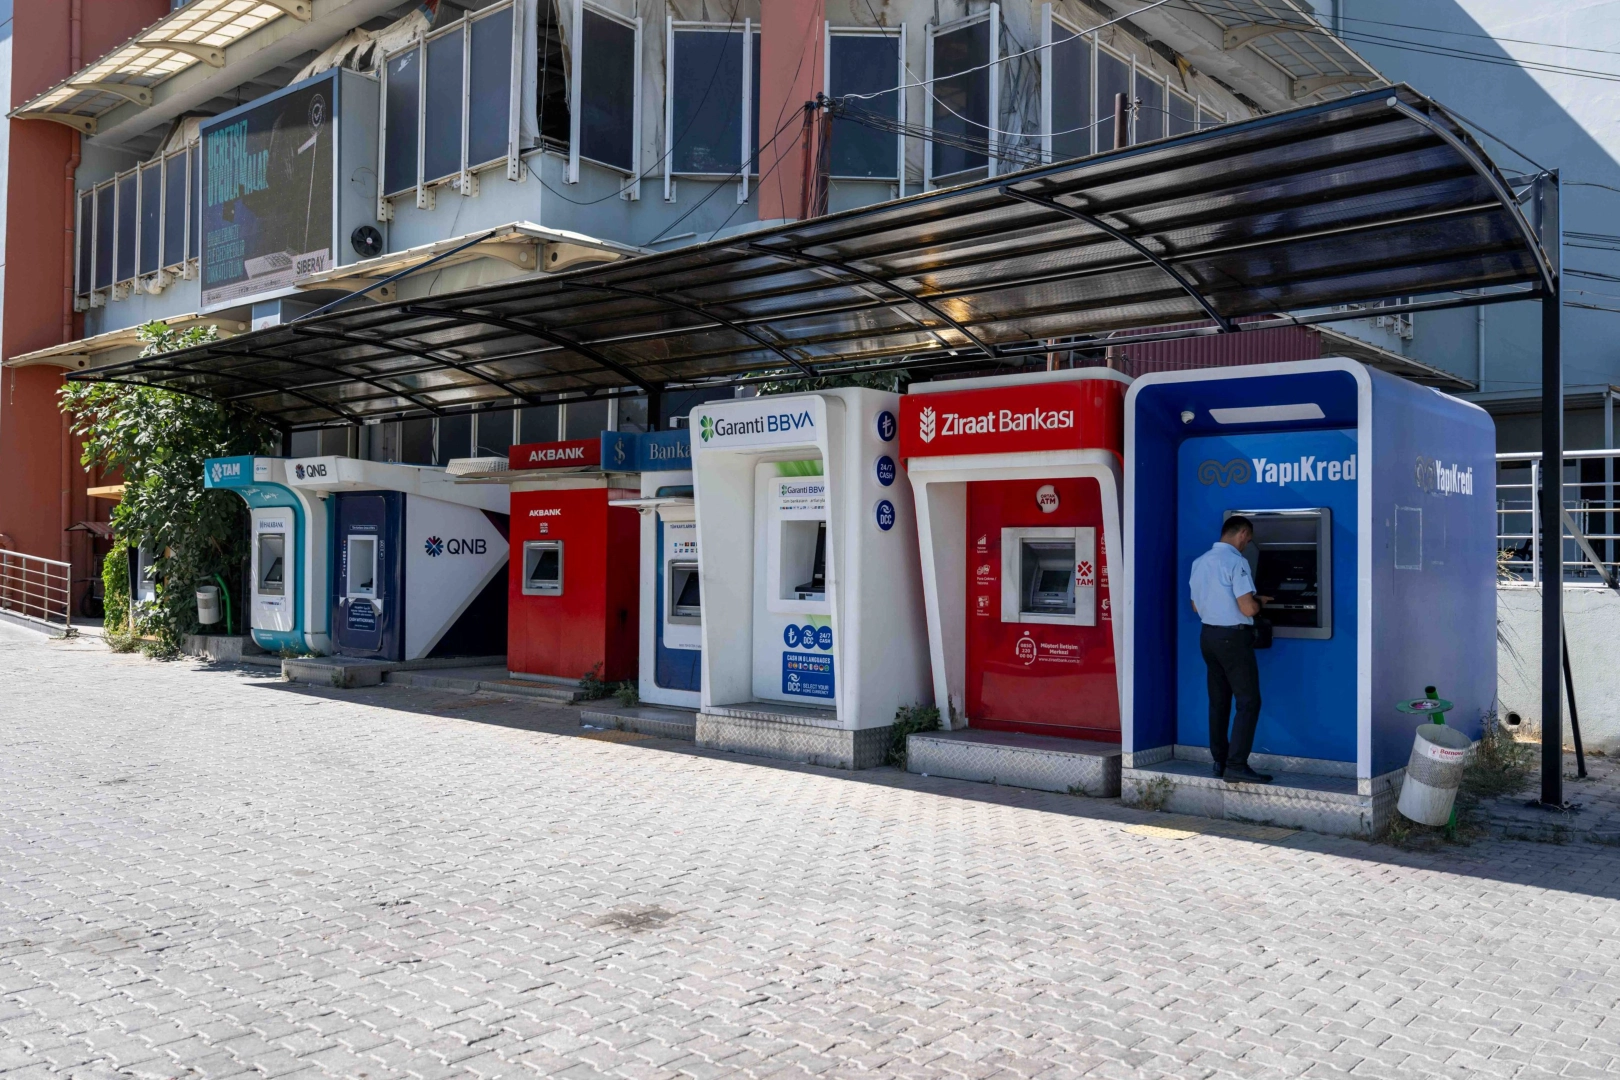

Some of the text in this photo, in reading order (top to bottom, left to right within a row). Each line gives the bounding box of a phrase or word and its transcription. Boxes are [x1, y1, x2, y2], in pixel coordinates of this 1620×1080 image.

[715, 410, 814, 437] Garanti BBVA
[941, 407, 1074, 436] Ziraat Bankası
[528, 447, 584, 462] AKBANK
[649, 441, 691, 460] Banka
[222, 463, 240, 476] TAM
[306, 463, 327, 478] QNB
[880, 463, 893, 471] 24/7
[879, 471, 893, 479] CASH
[1435, 459, 1473, 496] YapıKredi
[787, 486, 807, 494] Garanti
[529, 508, 561, 517] AKBANK
[880, 514, 892, 525] DCC
[447, 538, 487, 555] QNB
[1076, 578, 1094, 586] TAM
[803, 636, 814, 645] DCC
[806, 656, 831, 664] LANGUAGES
[787, 681, 800, 692] DCC
[802, 682, 817, 690] SELECT
